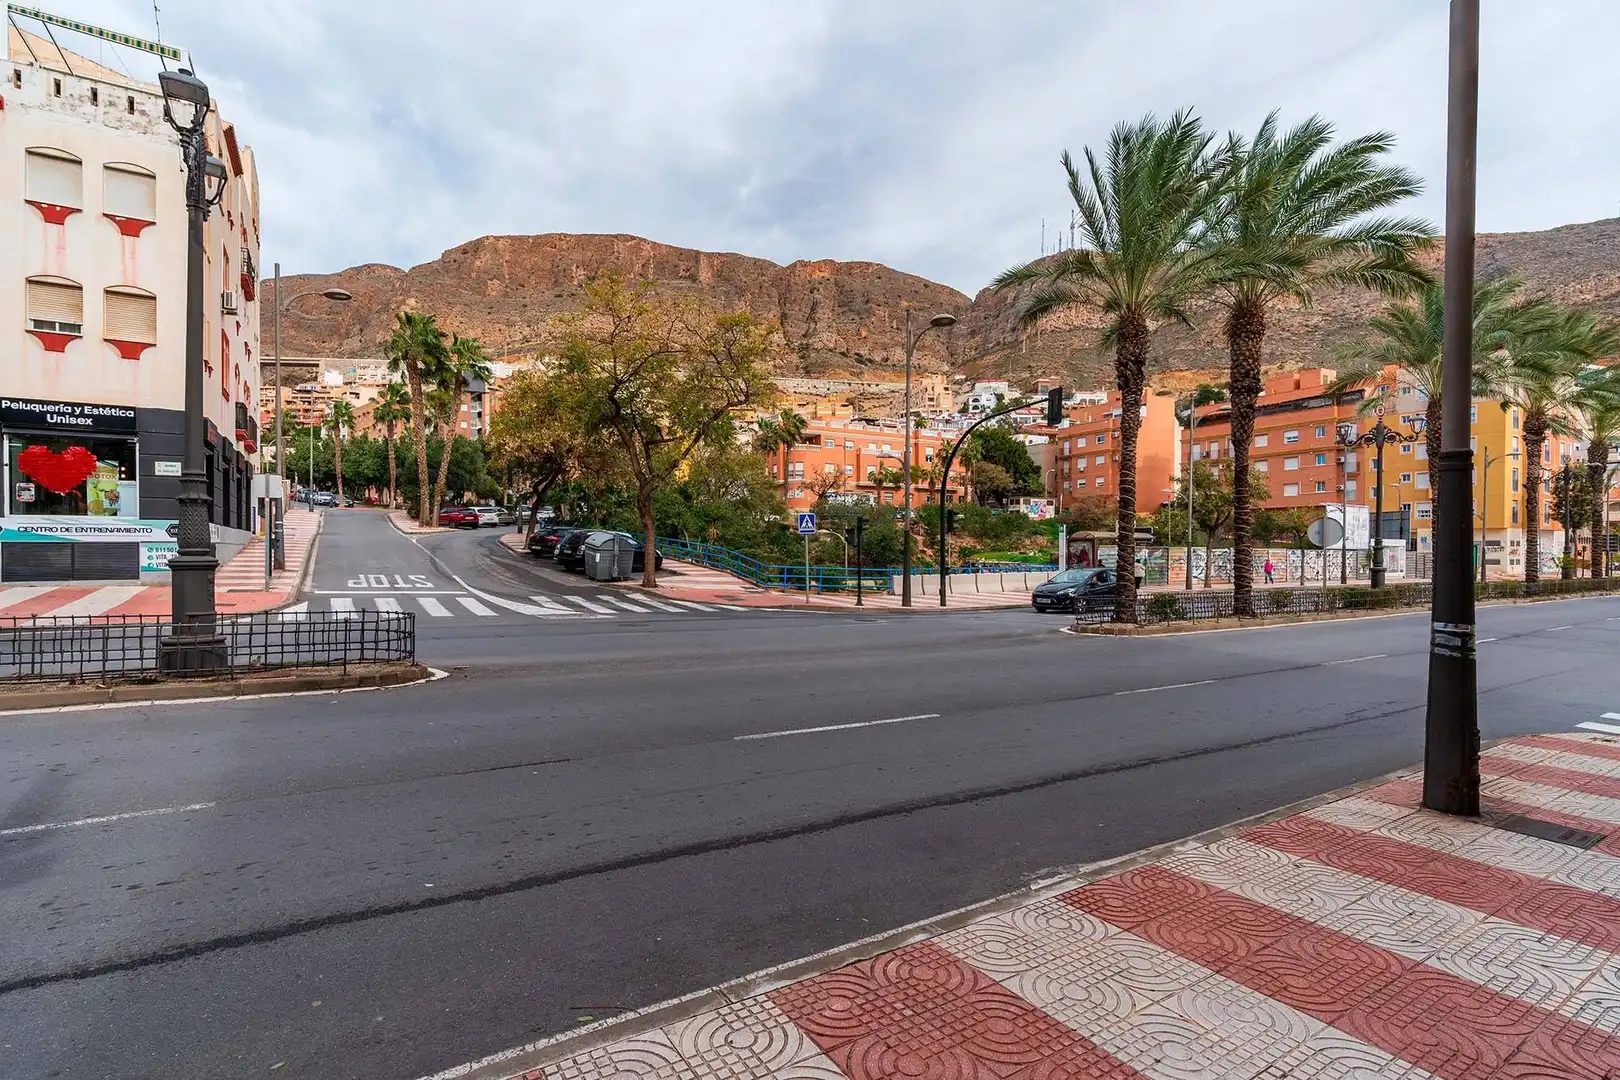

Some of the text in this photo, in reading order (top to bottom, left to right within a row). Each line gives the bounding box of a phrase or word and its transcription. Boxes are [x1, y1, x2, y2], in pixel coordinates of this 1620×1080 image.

[1, 400, 135, 417] Peluquería y Estética
[46, 414, 93, 425] Unisex
[75, 526, 153, 534] ENTRENAMIENTO
[347, 574, 435, 588] STOP
